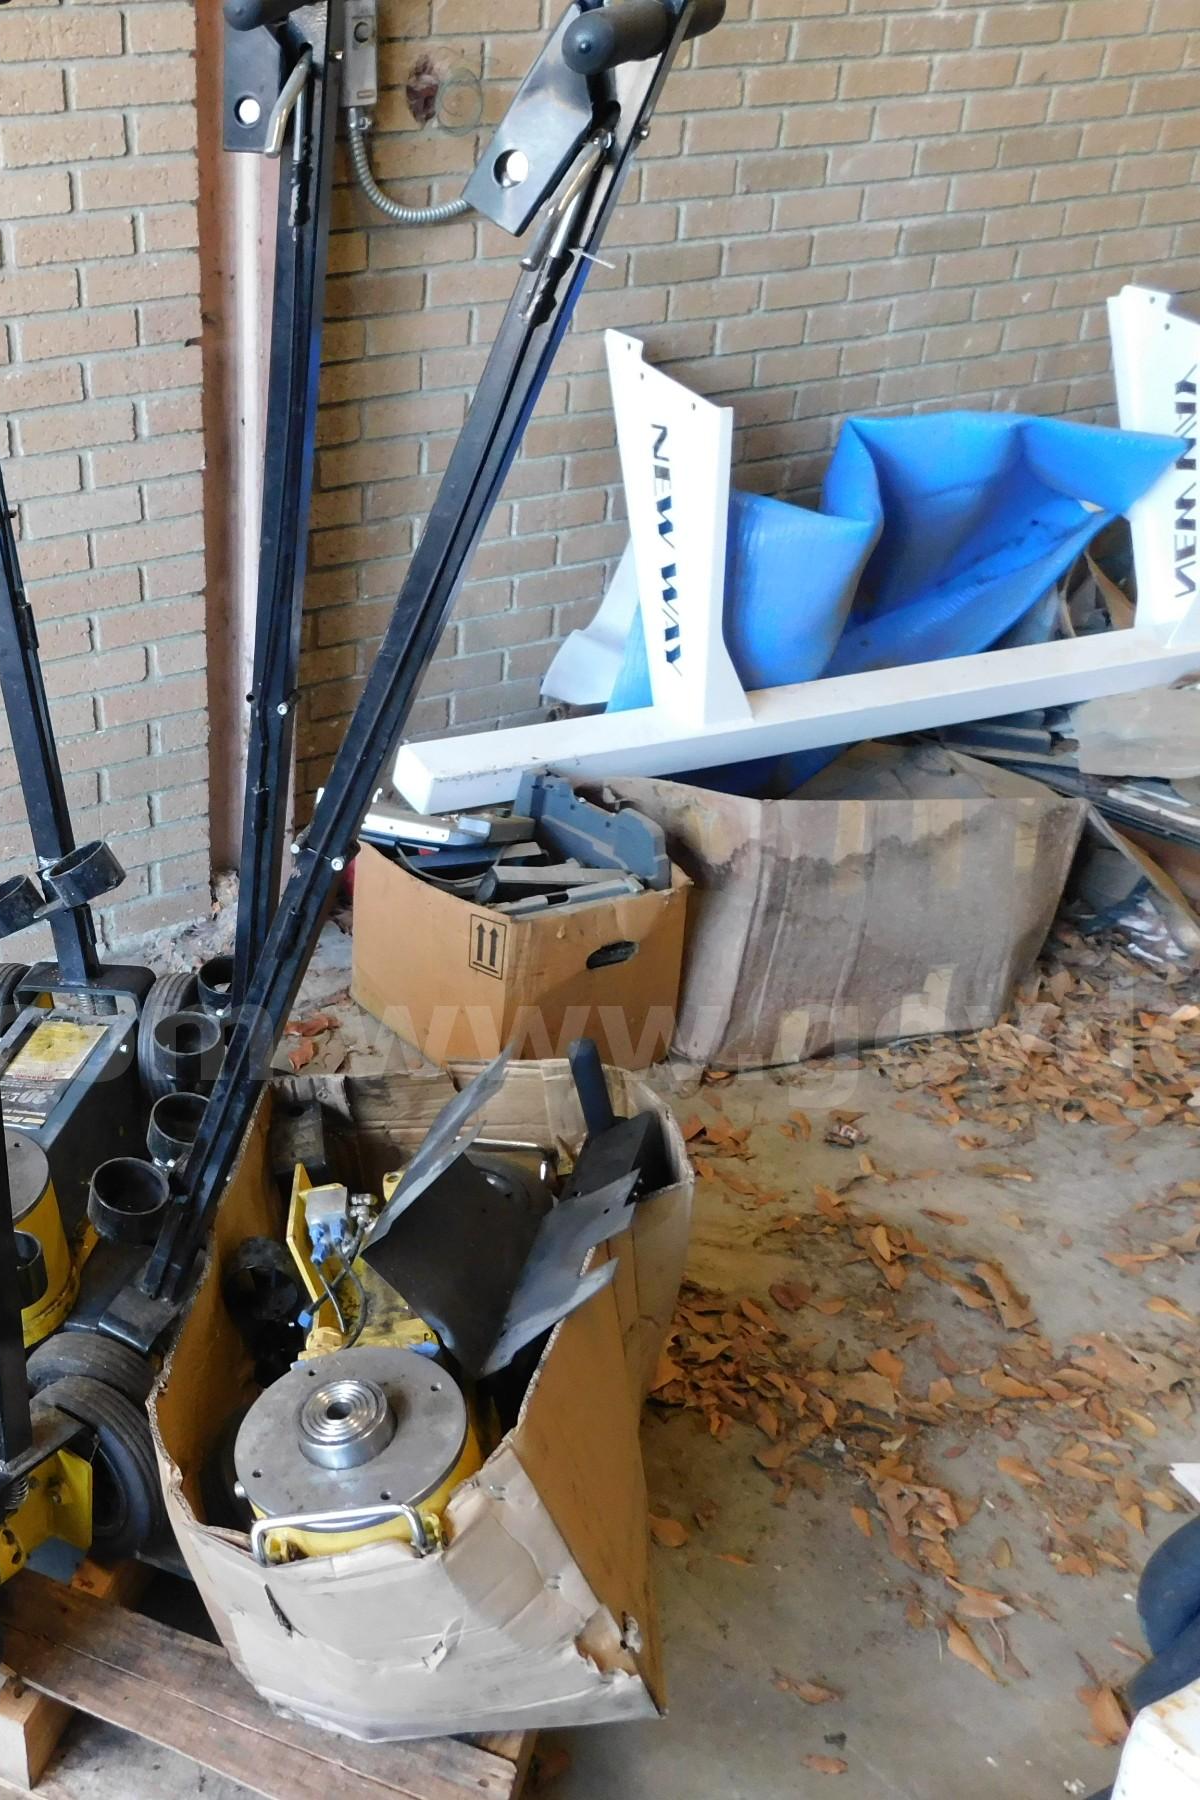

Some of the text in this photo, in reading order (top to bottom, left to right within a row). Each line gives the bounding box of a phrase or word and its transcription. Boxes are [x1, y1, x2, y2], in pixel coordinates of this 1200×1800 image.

[650, 423, 684, 677] NEW WAY
[1174, 363, 1197, 599] NEW WAY
